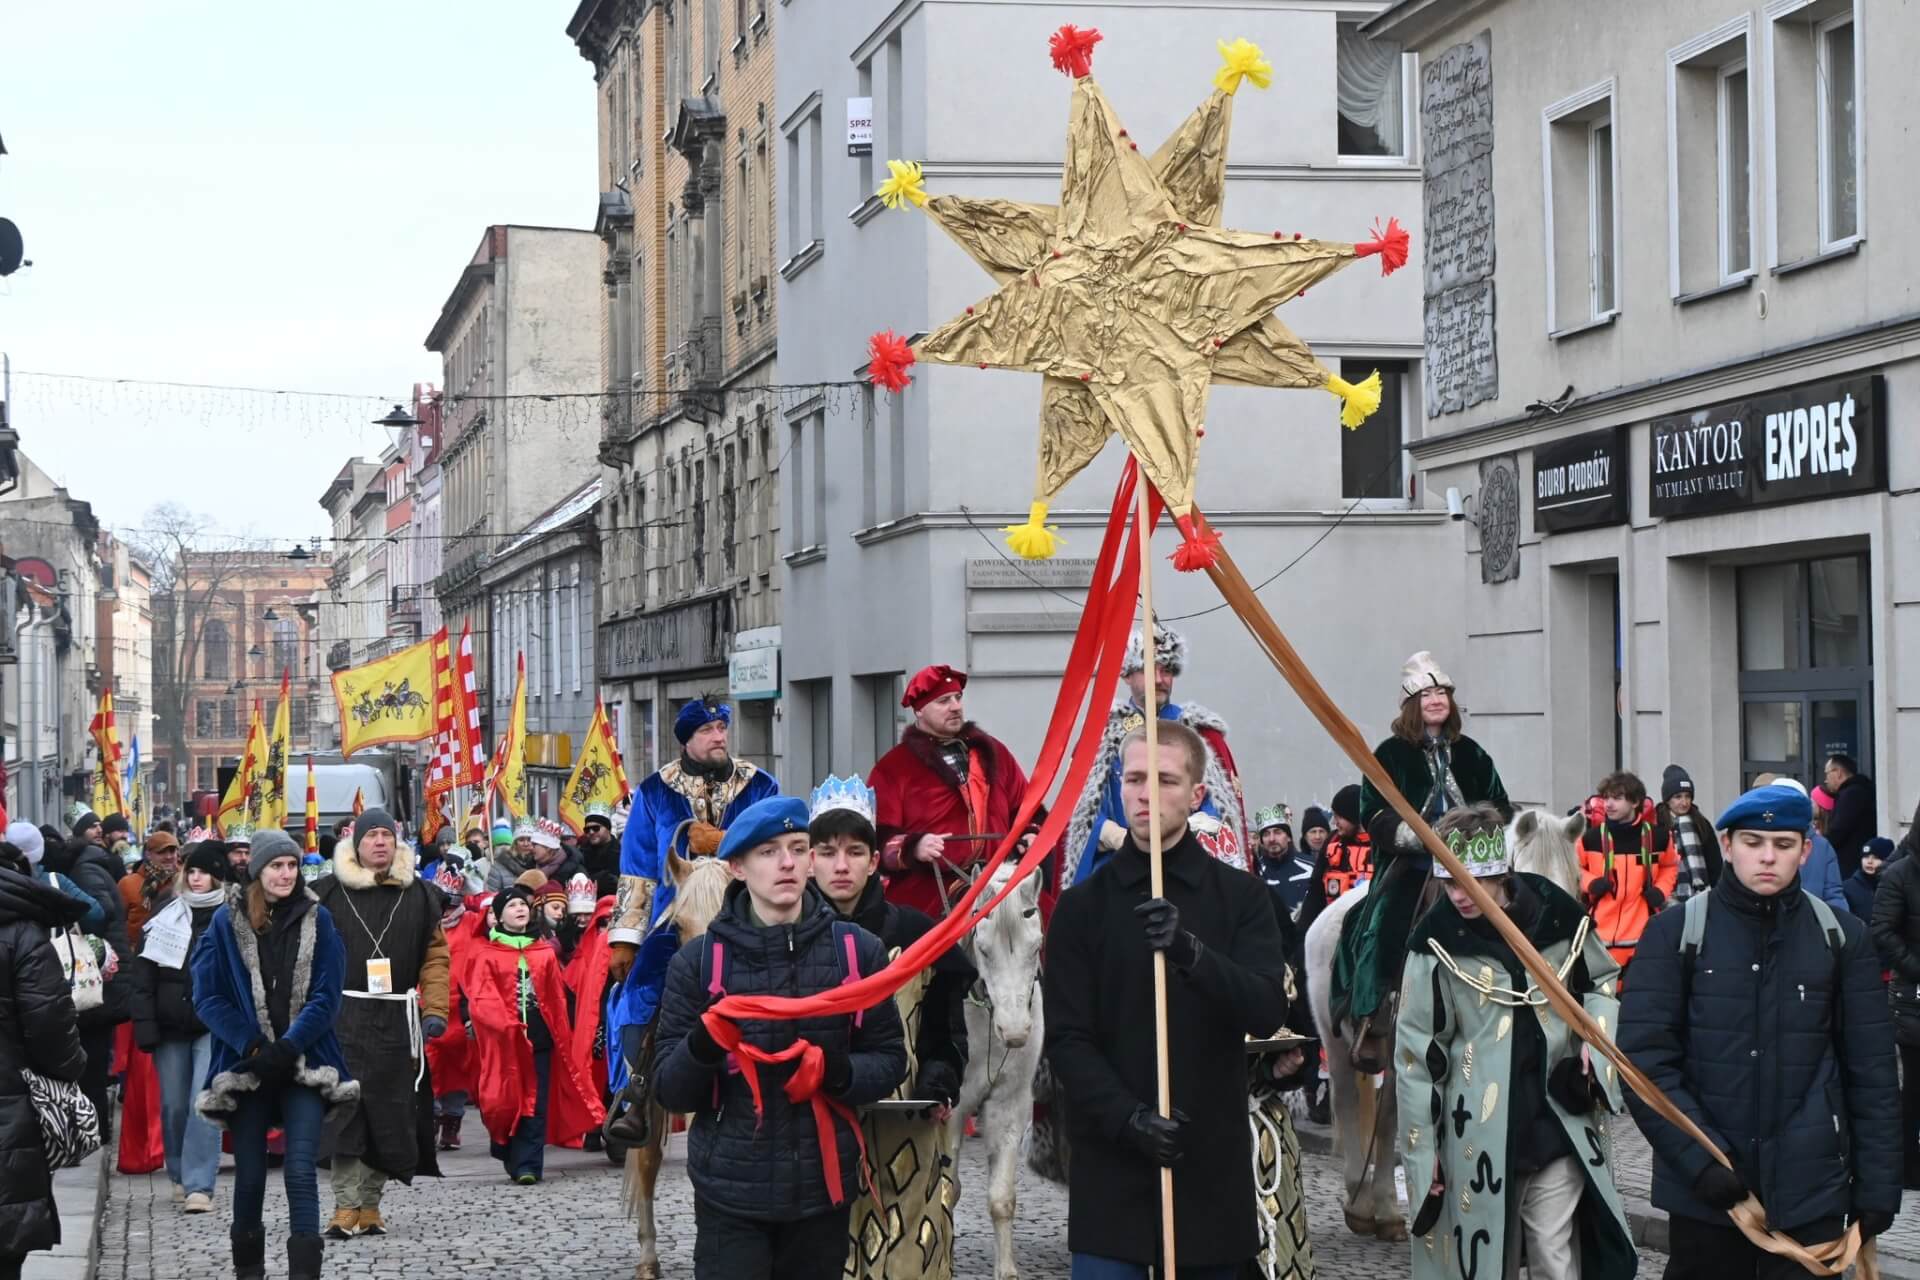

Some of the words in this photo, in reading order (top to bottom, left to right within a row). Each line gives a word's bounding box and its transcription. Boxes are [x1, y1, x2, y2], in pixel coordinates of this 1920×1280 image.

[1655, 420, 1744, 474] KANTOR
[1538, 466, 1566, 499] BIURO
[1568, 449, 1610, 493] PODRÓŻY
[1655, 477, 1704, 499] WYMIANY
[1707, 470, 1744, 491] WALUT
